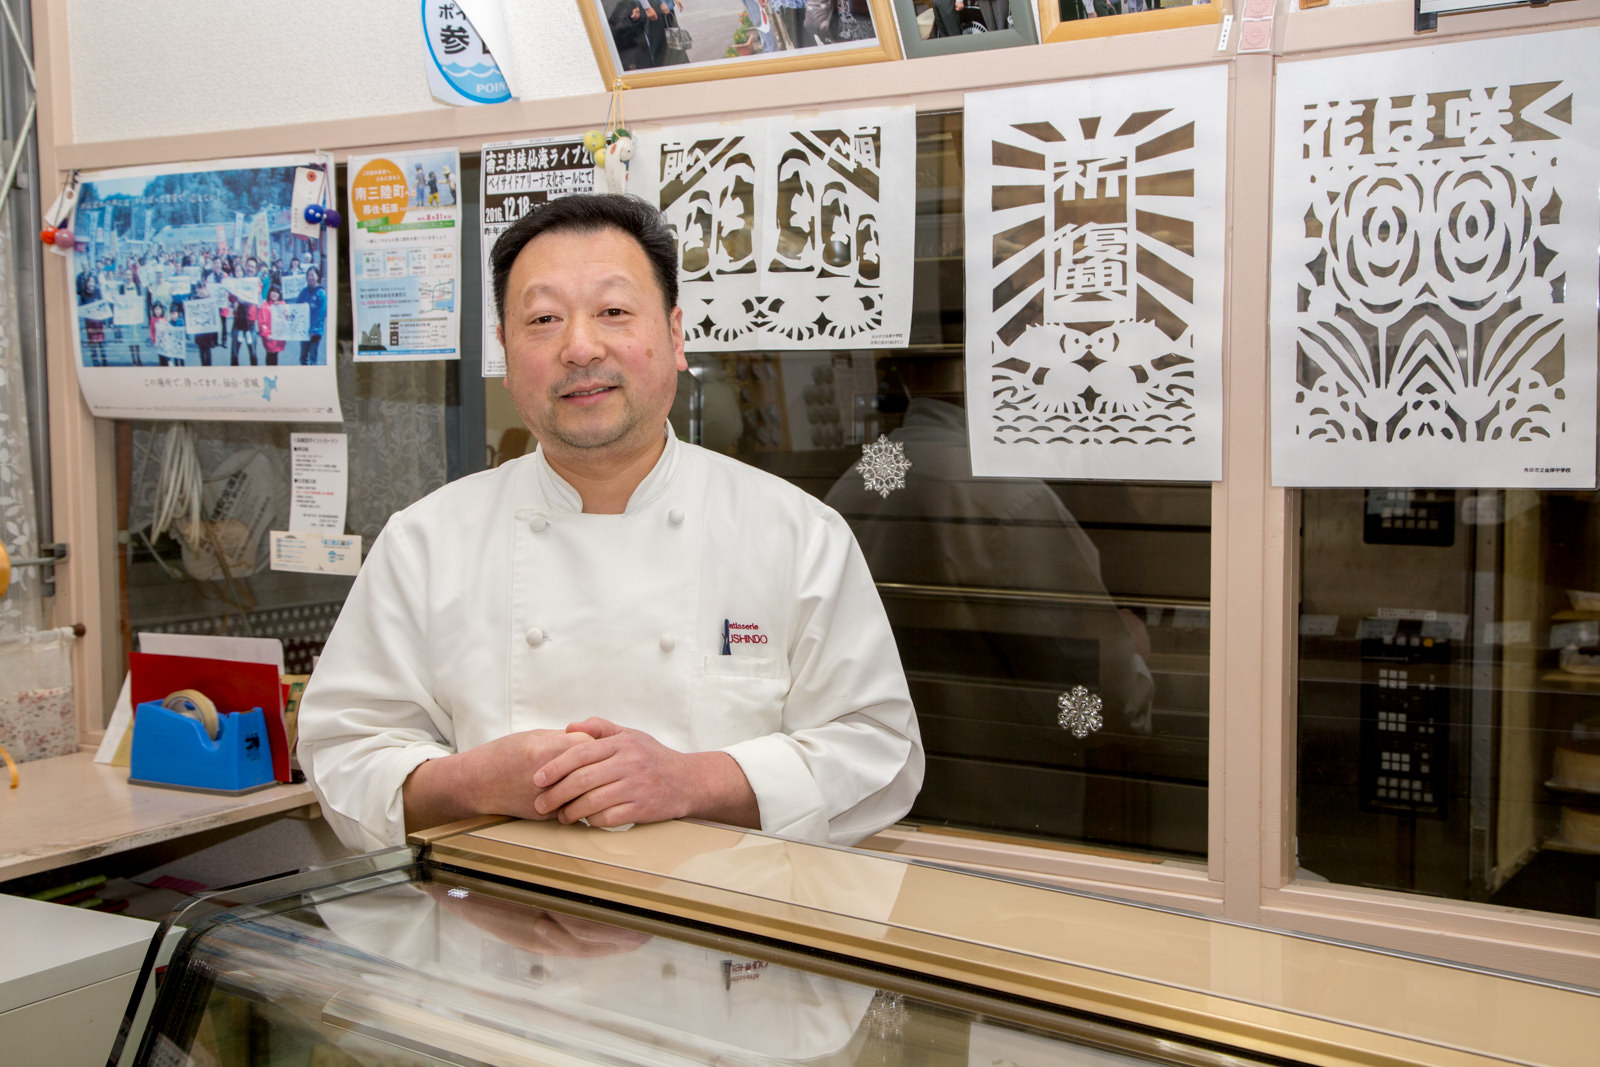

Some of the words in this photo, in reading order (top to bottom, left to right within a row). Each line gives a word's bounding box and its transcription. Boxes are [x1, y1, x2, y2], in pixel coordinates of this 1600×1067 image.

[440, 25, 491, 54] 参
[1303, 80, 1573, 158] 花は咲く
[722, 633, 768, 644] USHINDO
